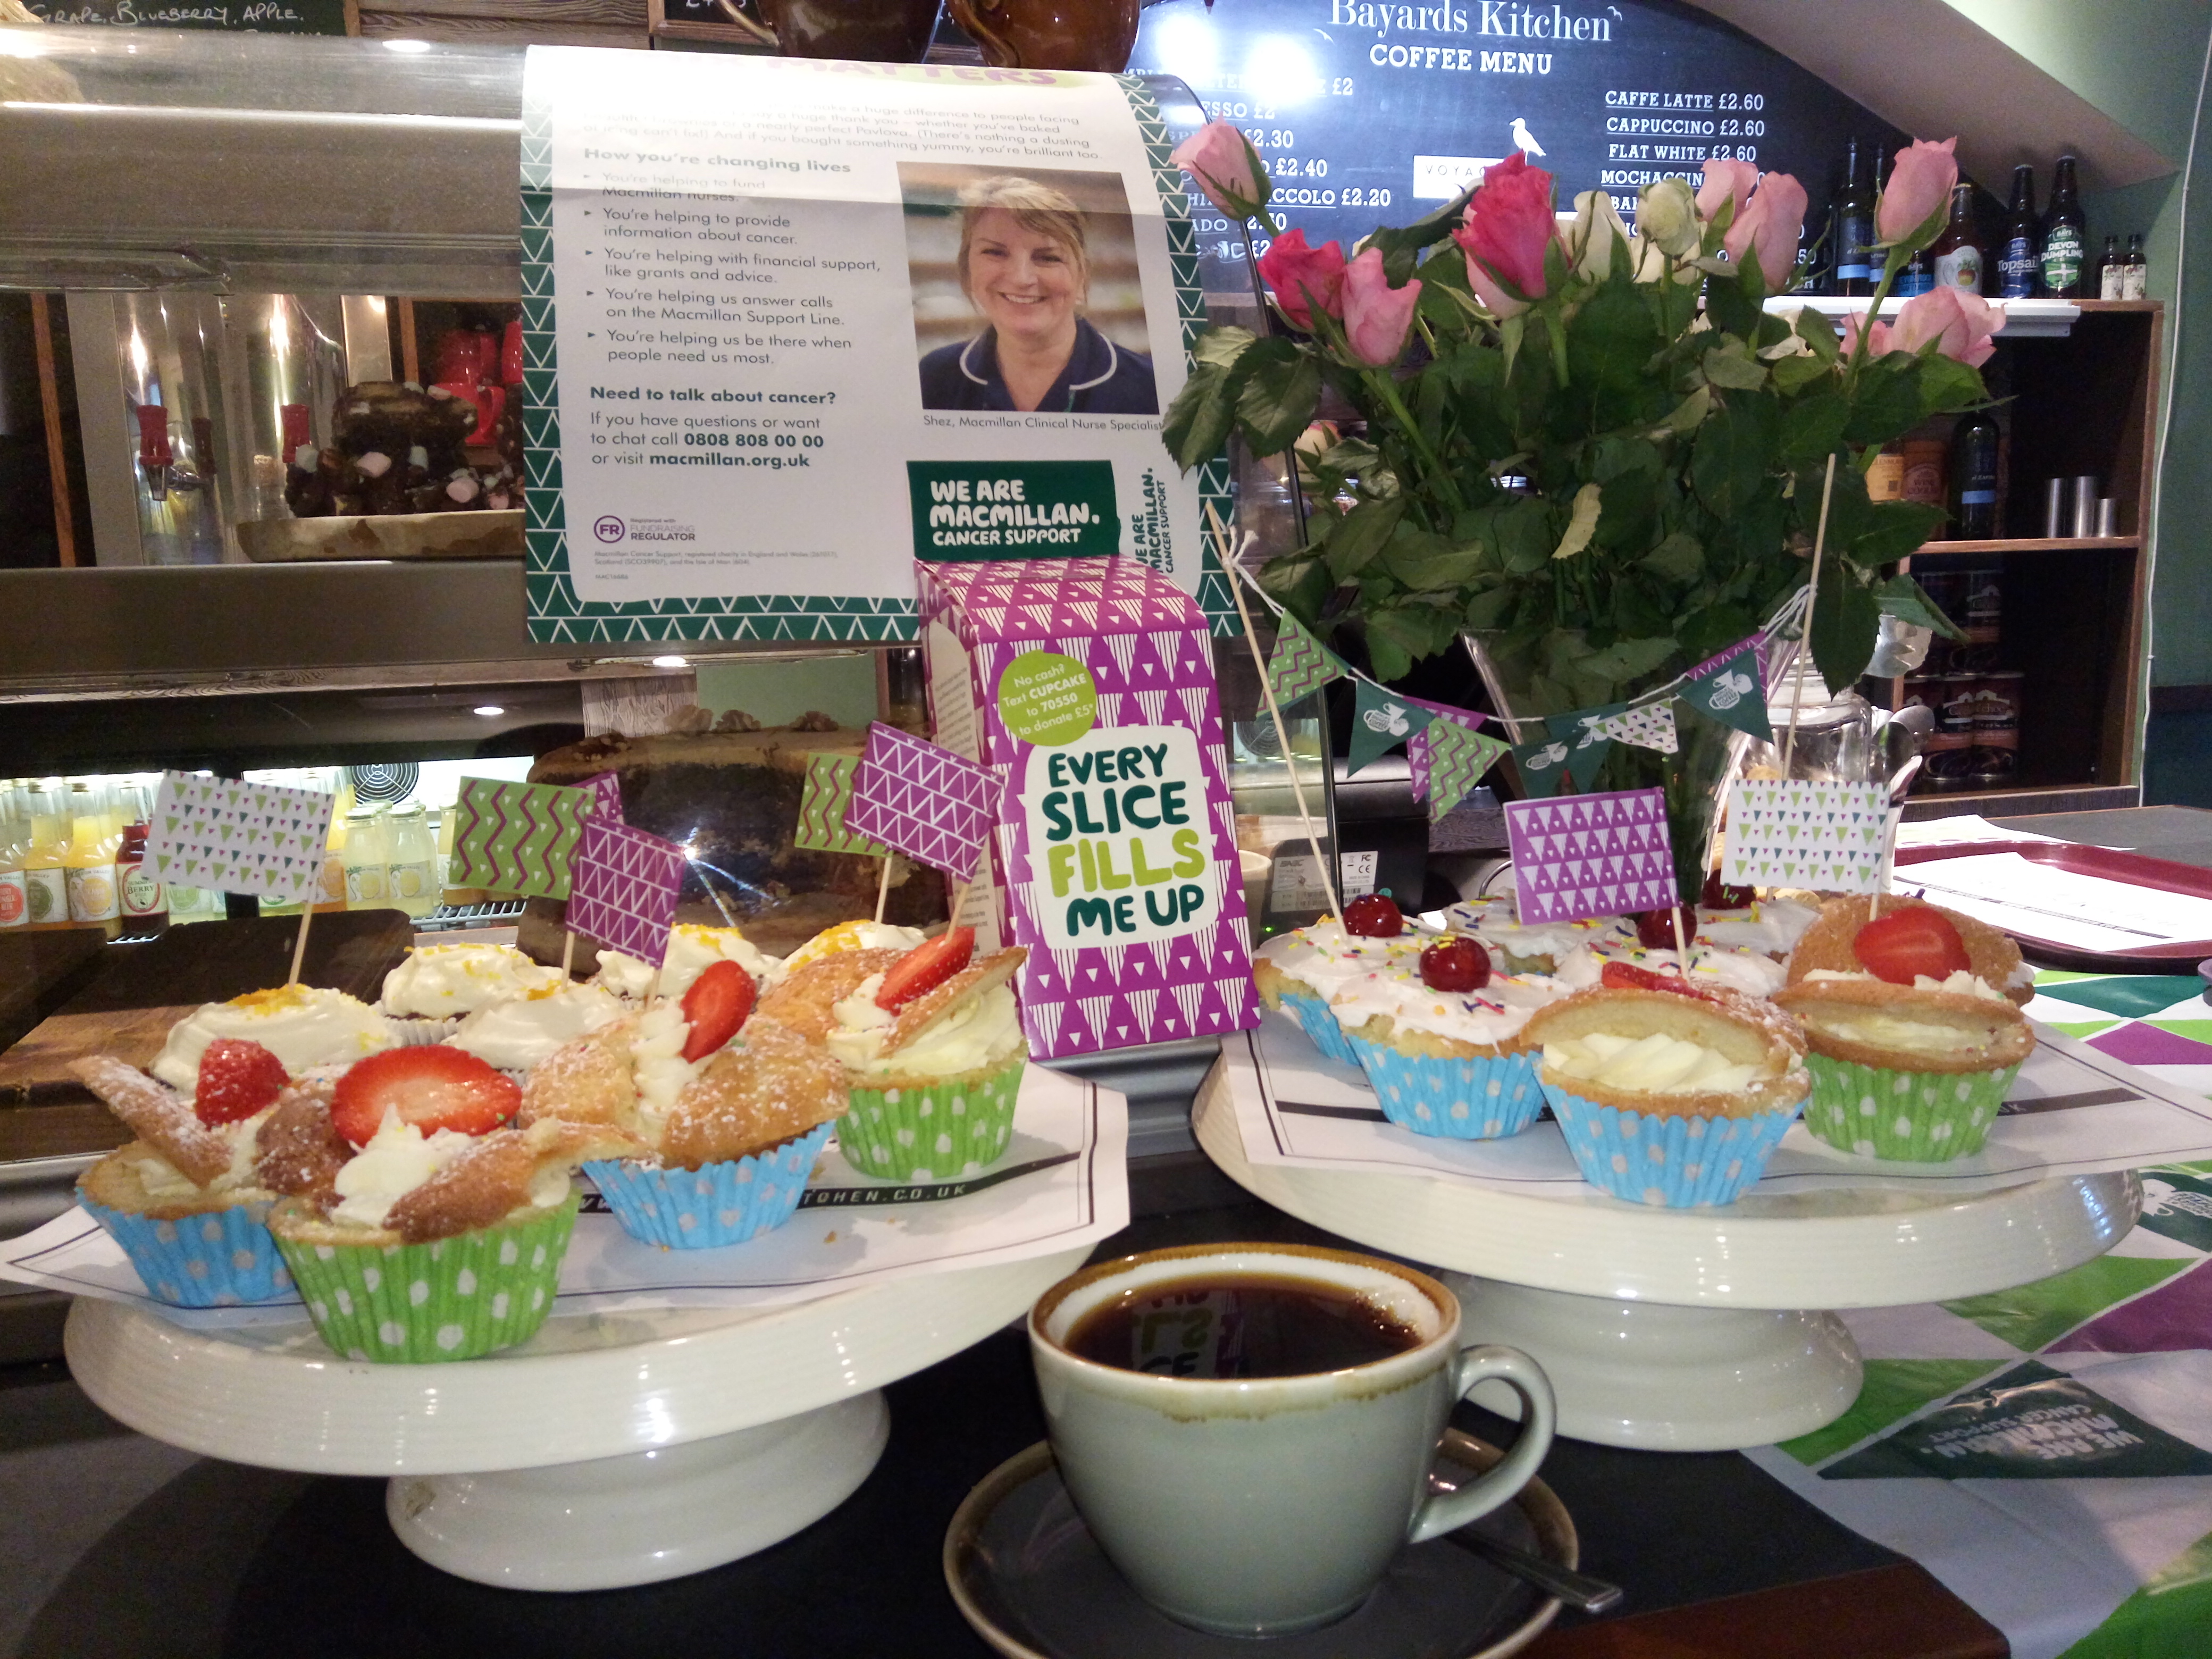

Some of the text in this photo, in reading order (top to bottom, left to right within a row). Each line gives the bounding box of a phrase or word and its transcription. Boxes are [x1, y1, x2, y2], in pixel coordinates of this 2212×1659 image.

[1327, 0, 1612, 41] Bayards Kitchen
[1370, 44, 1553, 74] COFFEE MENU
[1333, 77, 1353, 96] £2
[1605, 90, 1764, 111] CAFFE LATTE £2.60
[916, 120, 968, 129] whether
[1020, 124, 1061, 133] baked
[991, 113, 1035, 122] people
[1040, 114, 1079, 125] facing
[1606, 117, 1765, 137] CAPPUCCINO £2.60
[757, 122, 799, 133] nearly
[805, 124, 851, 134] perfect
[975, 133, 1025, 145] nothing
[1043, 136, 1090, 149] dusting
[760, 133, 786, 143] you
[791, 135, 841, 147] bought
[845, 139, 917, 151] something
[921, 142, 974, 154] yummy,
[978, 144, 1020, 155] you're
[1024, 146, 1074, 157] brilliant
[584, 148, 850, 172] How you're changing lives
[1608, 144, 1757, 162] FLAT WHITE £260
[1276, 158, 1328, 177] £2.40
[1341, 188, 1391, 207] £2.20
[603, 208, 790, 227] You're helping to provide
[605, 225, 798, 244] information about cancer.
[2040, 249, 2084, 262] DUMPLING
[2048, 241, 2080, 252] DEVON
[605, 248, 879, 272] You're helping with financial support,
[606, 264, 778, 283] like grants and advice.
[606, 288, 652, 300] You're
[658, 290, 715, 306] helping
[743, 297, 794, 306] answer
[801, 296, 832, 307] calls
[632, 306, 655, 318] the
[661, 308, 741, 321] Macmillan
[747, 311, 805, 325] Support
[811, 314, 843, 324] Line.
[607, 330, 654, 342] You're
[660, 331, 717, 347] helping
[745, 334, 763, 346] be
[769, 335, 806, 347] there
[812, 336, 851, 348] when
[608, 349, 661, 363] people
[668, 350, 705, 362] need
[734, 354, 773, 363] most.
[591, 387, 835, 404] Need to talk about cancer?
[591, 411, 600, 424] If
[606, 416, 634, 428] you
[641, 413, 678, 426] have
[684, 415, 757, 429] questions
[784, 418, 819, 428] want
[924, 415, 1163, 431] Shez, Macmillan Clinical Nurse Specialist
[591, 432, 824, 448] to chat call 0808 808 00 00
[592, 451, 809, 470] or visit macmillan.org.uk
[930, 479, 1025, 502] WE ARE
[929, 502, 1100, 528] MACMILLAN.
[599, 524, 620, 535] FR
[1132, 514, 1146, 544] ARE
[1157, 480, 1174, 573] CANCER SUPPORT
[631, 533, 696, 541] REGULATOR
[932, 528, 1082, 547] CANCER SUPPORT
[1014, 663, 1065, 688] No cash?
[1002, 673, 1087, 707] Text CUPCAKE
[1026, 692, 1078, 717] to 70550
[1019, 726, 1032, 735] to
[1033, 712, 1074, 732] donate
[1048, 743, 1168, 788] EVERY
[1041, 780, 1191, 842] SLICE
[1046, 828, 1206, 898] FILLS
[1066, 884, 1204, 937] ME UP
